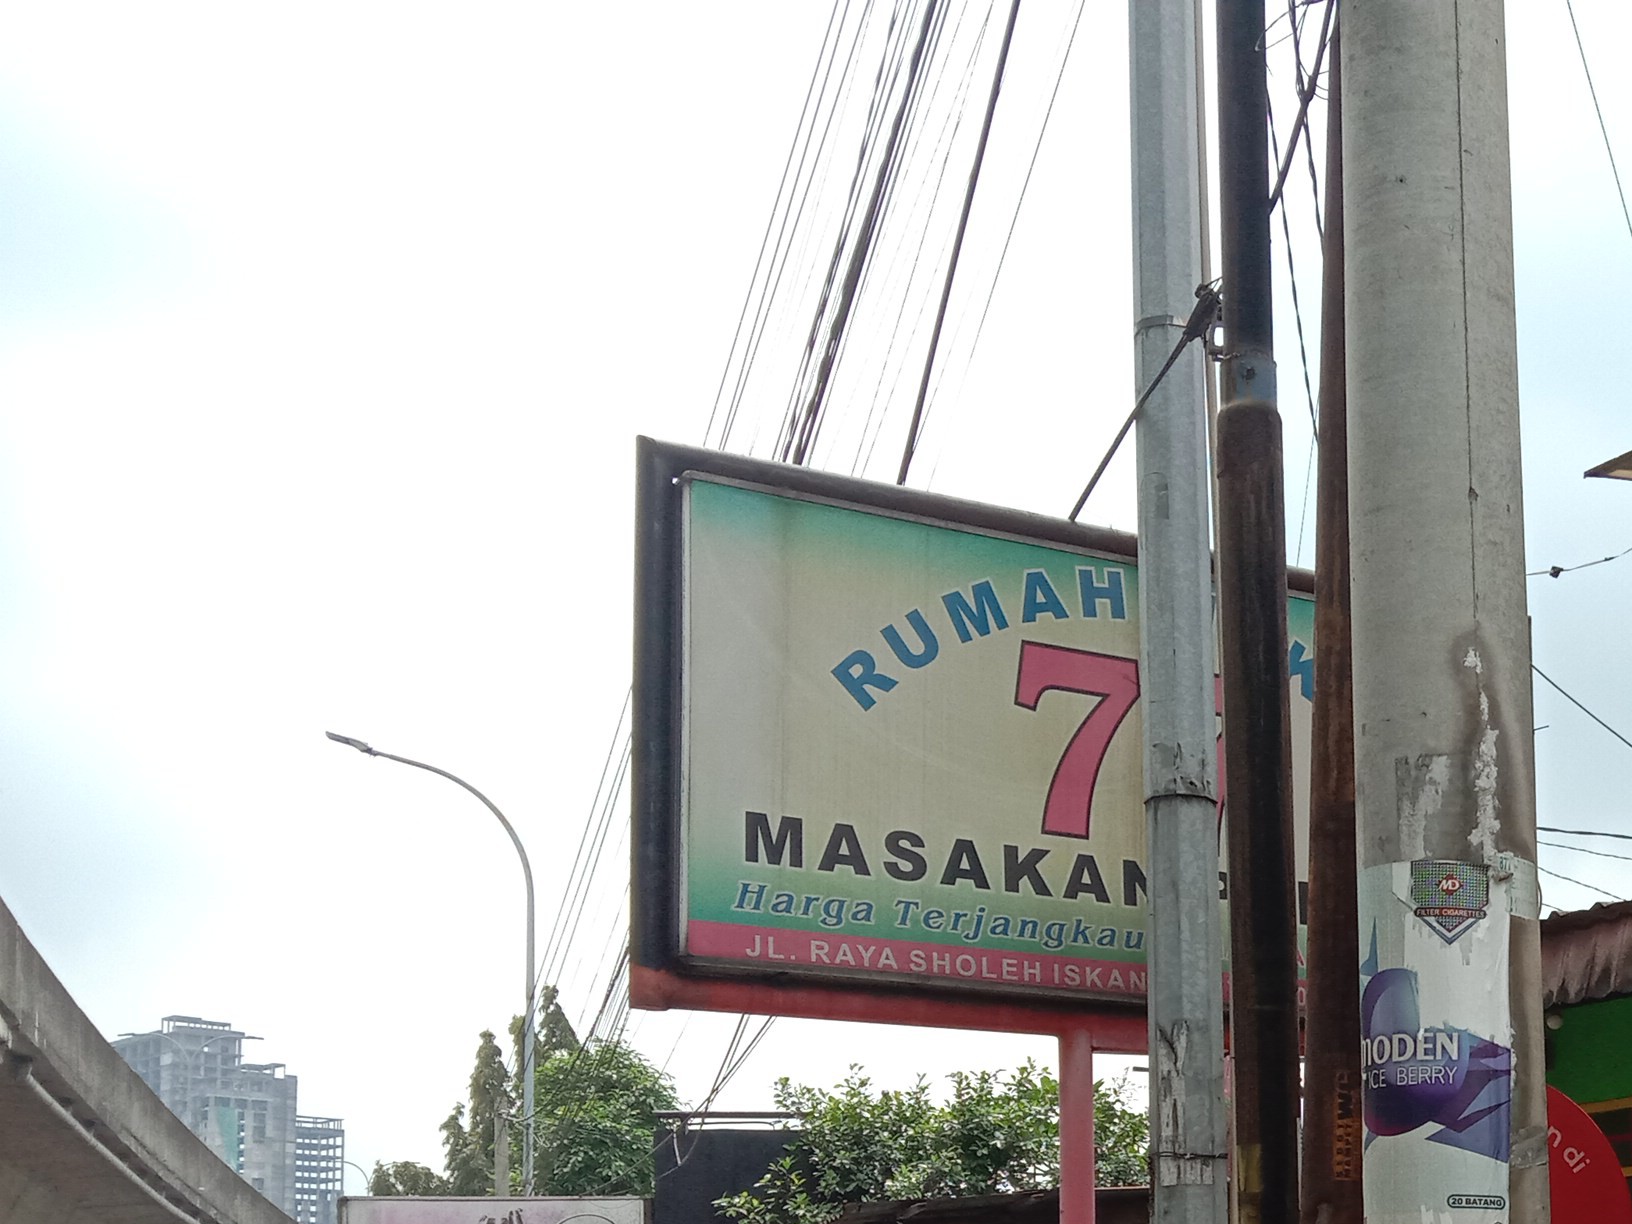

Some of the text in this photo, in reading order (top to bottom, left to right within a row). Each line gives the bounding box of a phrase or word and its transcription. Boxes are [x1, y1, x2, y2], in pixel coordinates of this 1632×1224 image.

[830, 565, 1126, 711] RUMAH
[733, 881, 1144, 950] Harga Terjangkau
[1416, 908, 1485, 918] FILTER CIGARETTES
[746, 935, 1148, 992] JL. RAYA SHOLEH ISKAN
[1396, 1066, 1457, 1086] BERRY
[1563, 1146, 1591, 1174] di
[1451, 1198, 1502, 1207] 20 BATANG
